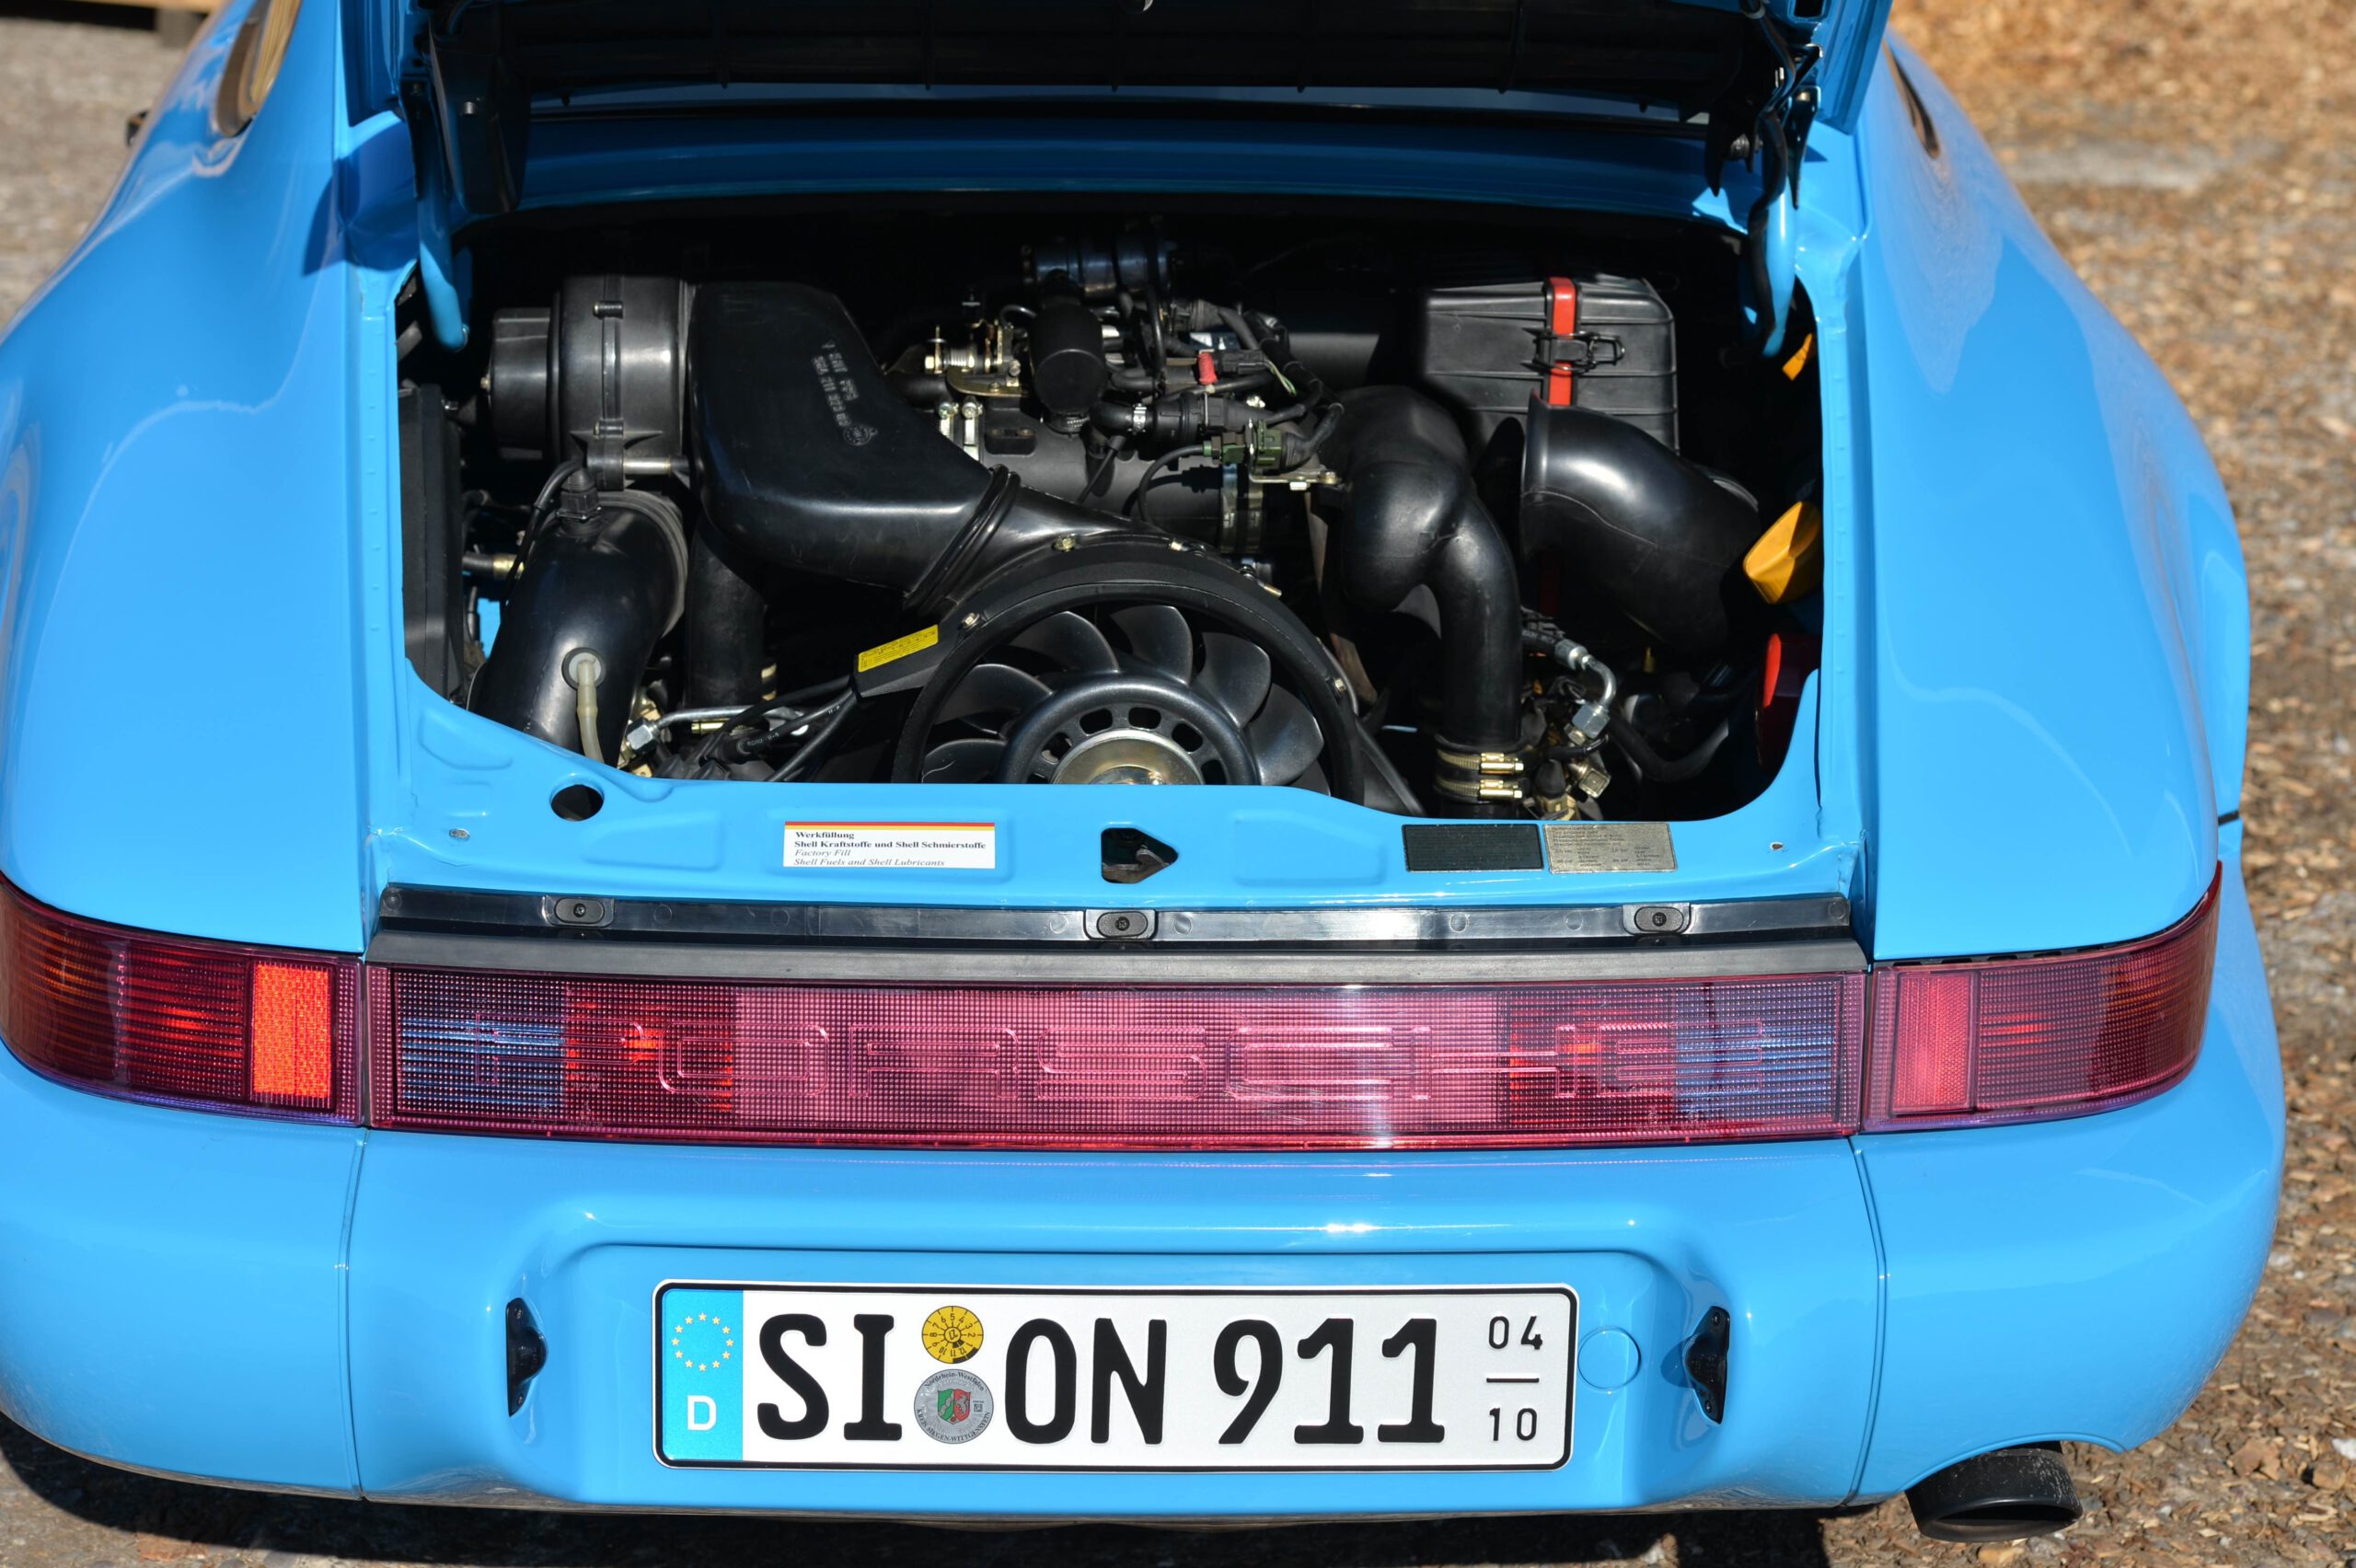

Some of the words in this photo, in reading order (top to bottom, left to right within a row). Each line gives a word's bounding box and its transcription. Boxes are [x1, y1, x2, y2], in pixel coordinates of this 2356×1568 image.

[795, 831, 855, 839] Werkfüllung
[921, 841, 987, 849] Schmierstoffe
[794, 848, 832, 858] Factory
[834, 848, 851, 857] Fill
[475, 1013, 1762, 1101] PORSCHE
[1488, 1316, 1542, 1350] 04
[757, 1313, 902, 1441] SI
[1005, 1318, 1167, 1444] ON
[1214, 1318, 1445, 1444] 911
[687, 1395, 717, 1431] D
[1489, 1408, 1537, 1441] 10
